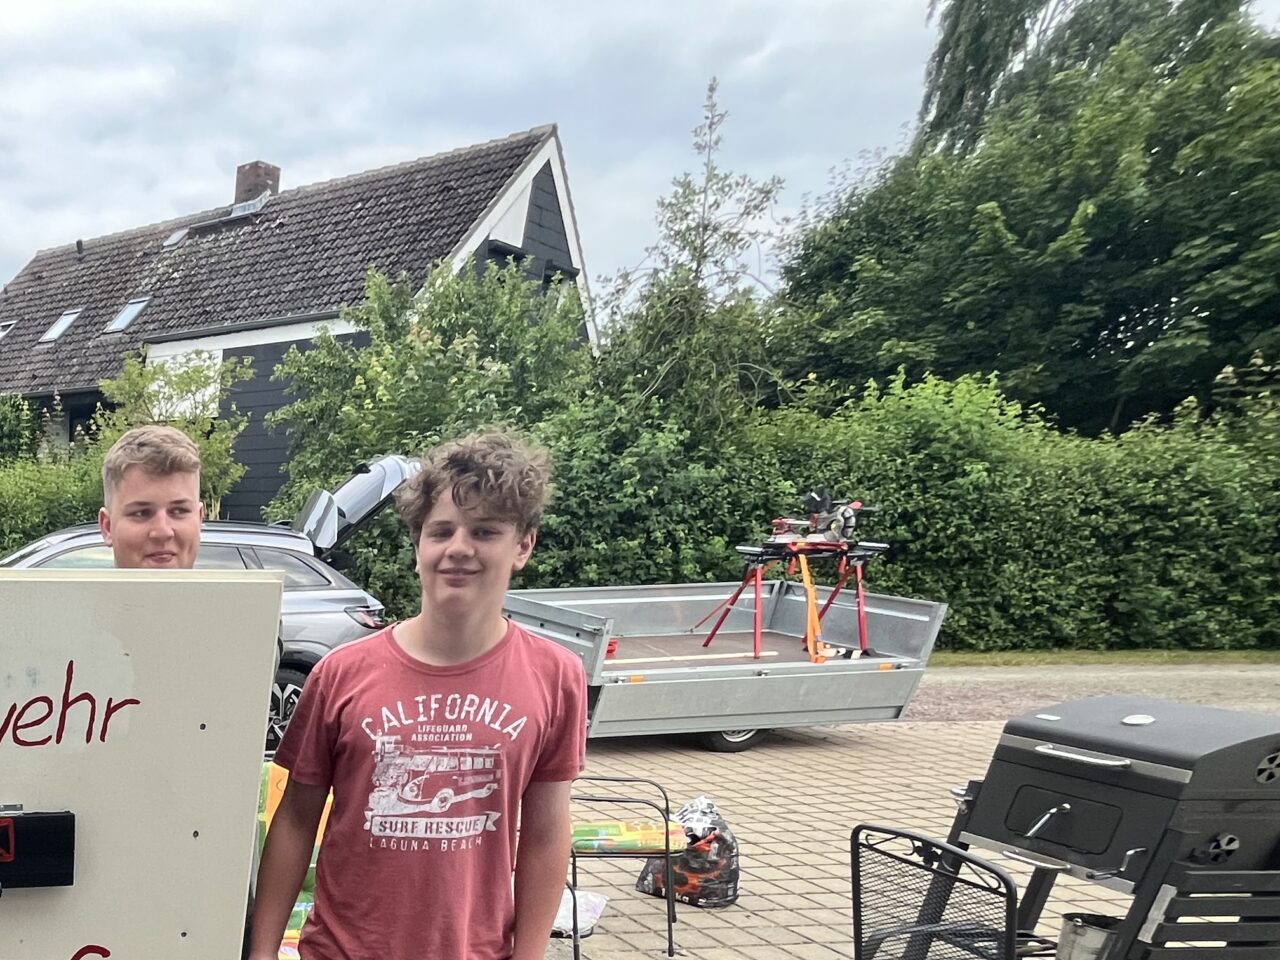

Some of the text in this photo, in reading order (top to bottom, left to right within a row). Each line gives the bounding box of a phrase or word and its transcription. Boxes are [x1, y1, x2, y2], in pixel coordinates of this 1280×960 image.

[361, 693, 528, 741] CALIFORNIA
[417, 724, 468, 733] LIFEGUARD
[411, 733, 473, 742] ASSOCIATION
[378, 818, 481, 835] SURF RESCUE
[369, 836, 482, 852] LAGUNA BEACH
